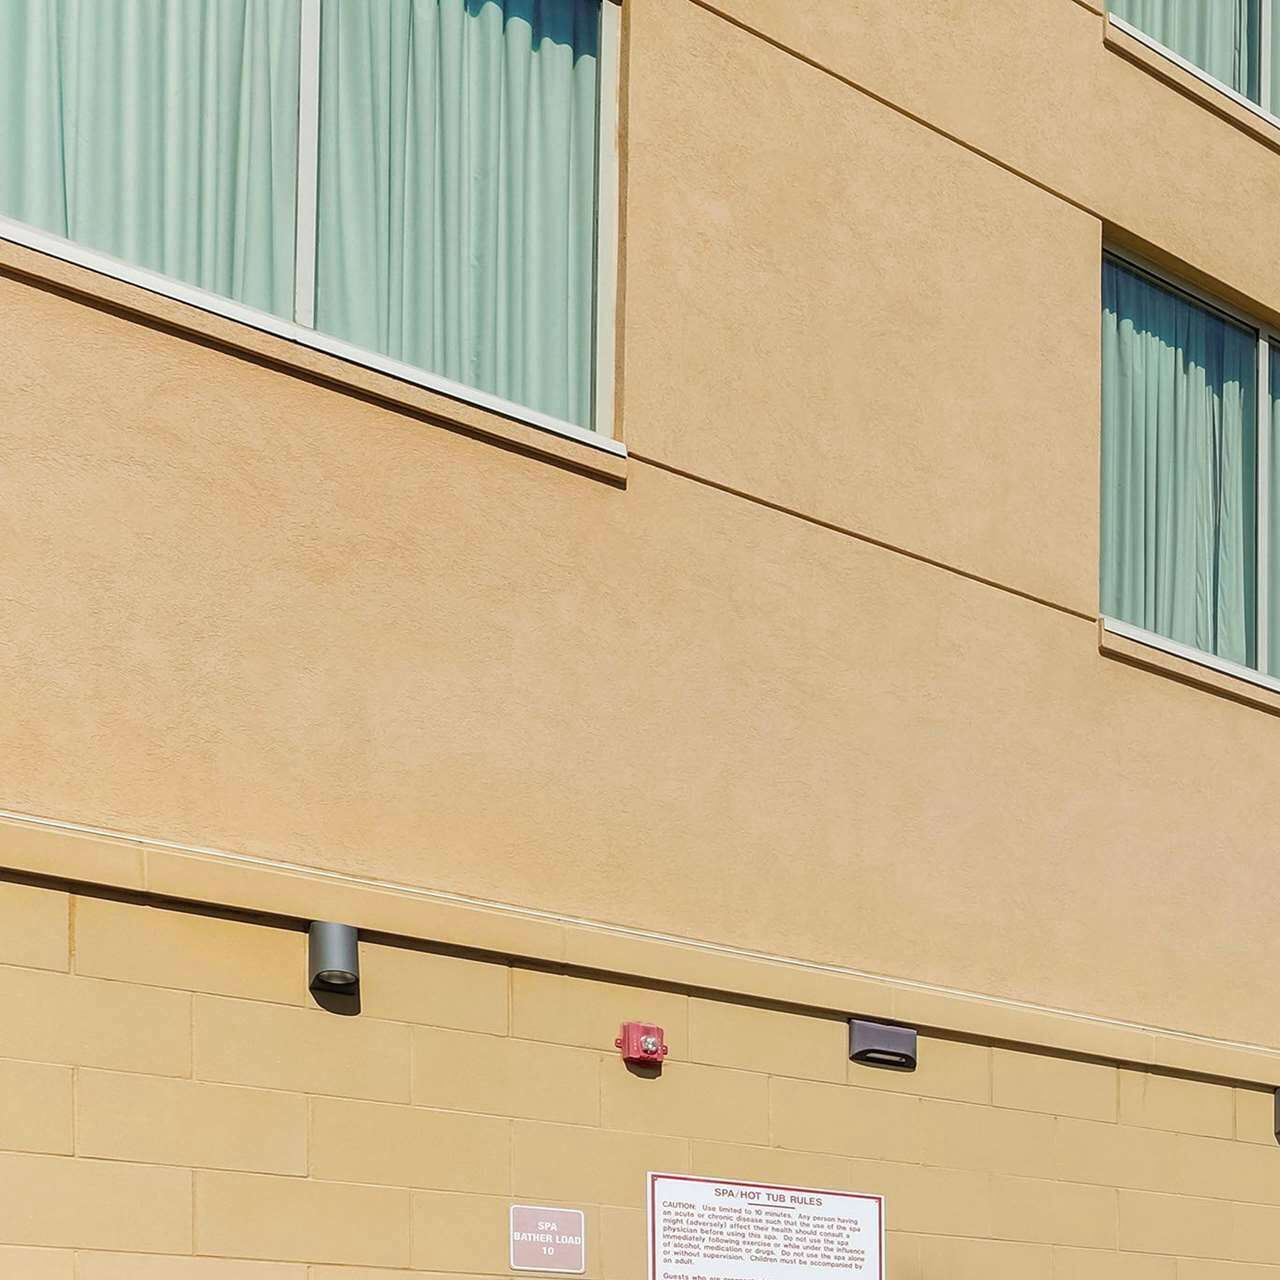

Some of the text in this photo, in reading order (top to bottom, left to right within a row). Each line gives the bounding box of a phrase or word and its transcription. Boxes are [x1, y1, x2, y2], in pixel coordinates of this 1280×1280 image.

[714, 1188, 822, 1206] SPA/HOT TUB RULES
[537, 1221, 558, 1232] SPA
[513, 1231, 581, 1245] BATHER LOAD
[542, 1246, 554, 1256] 10
